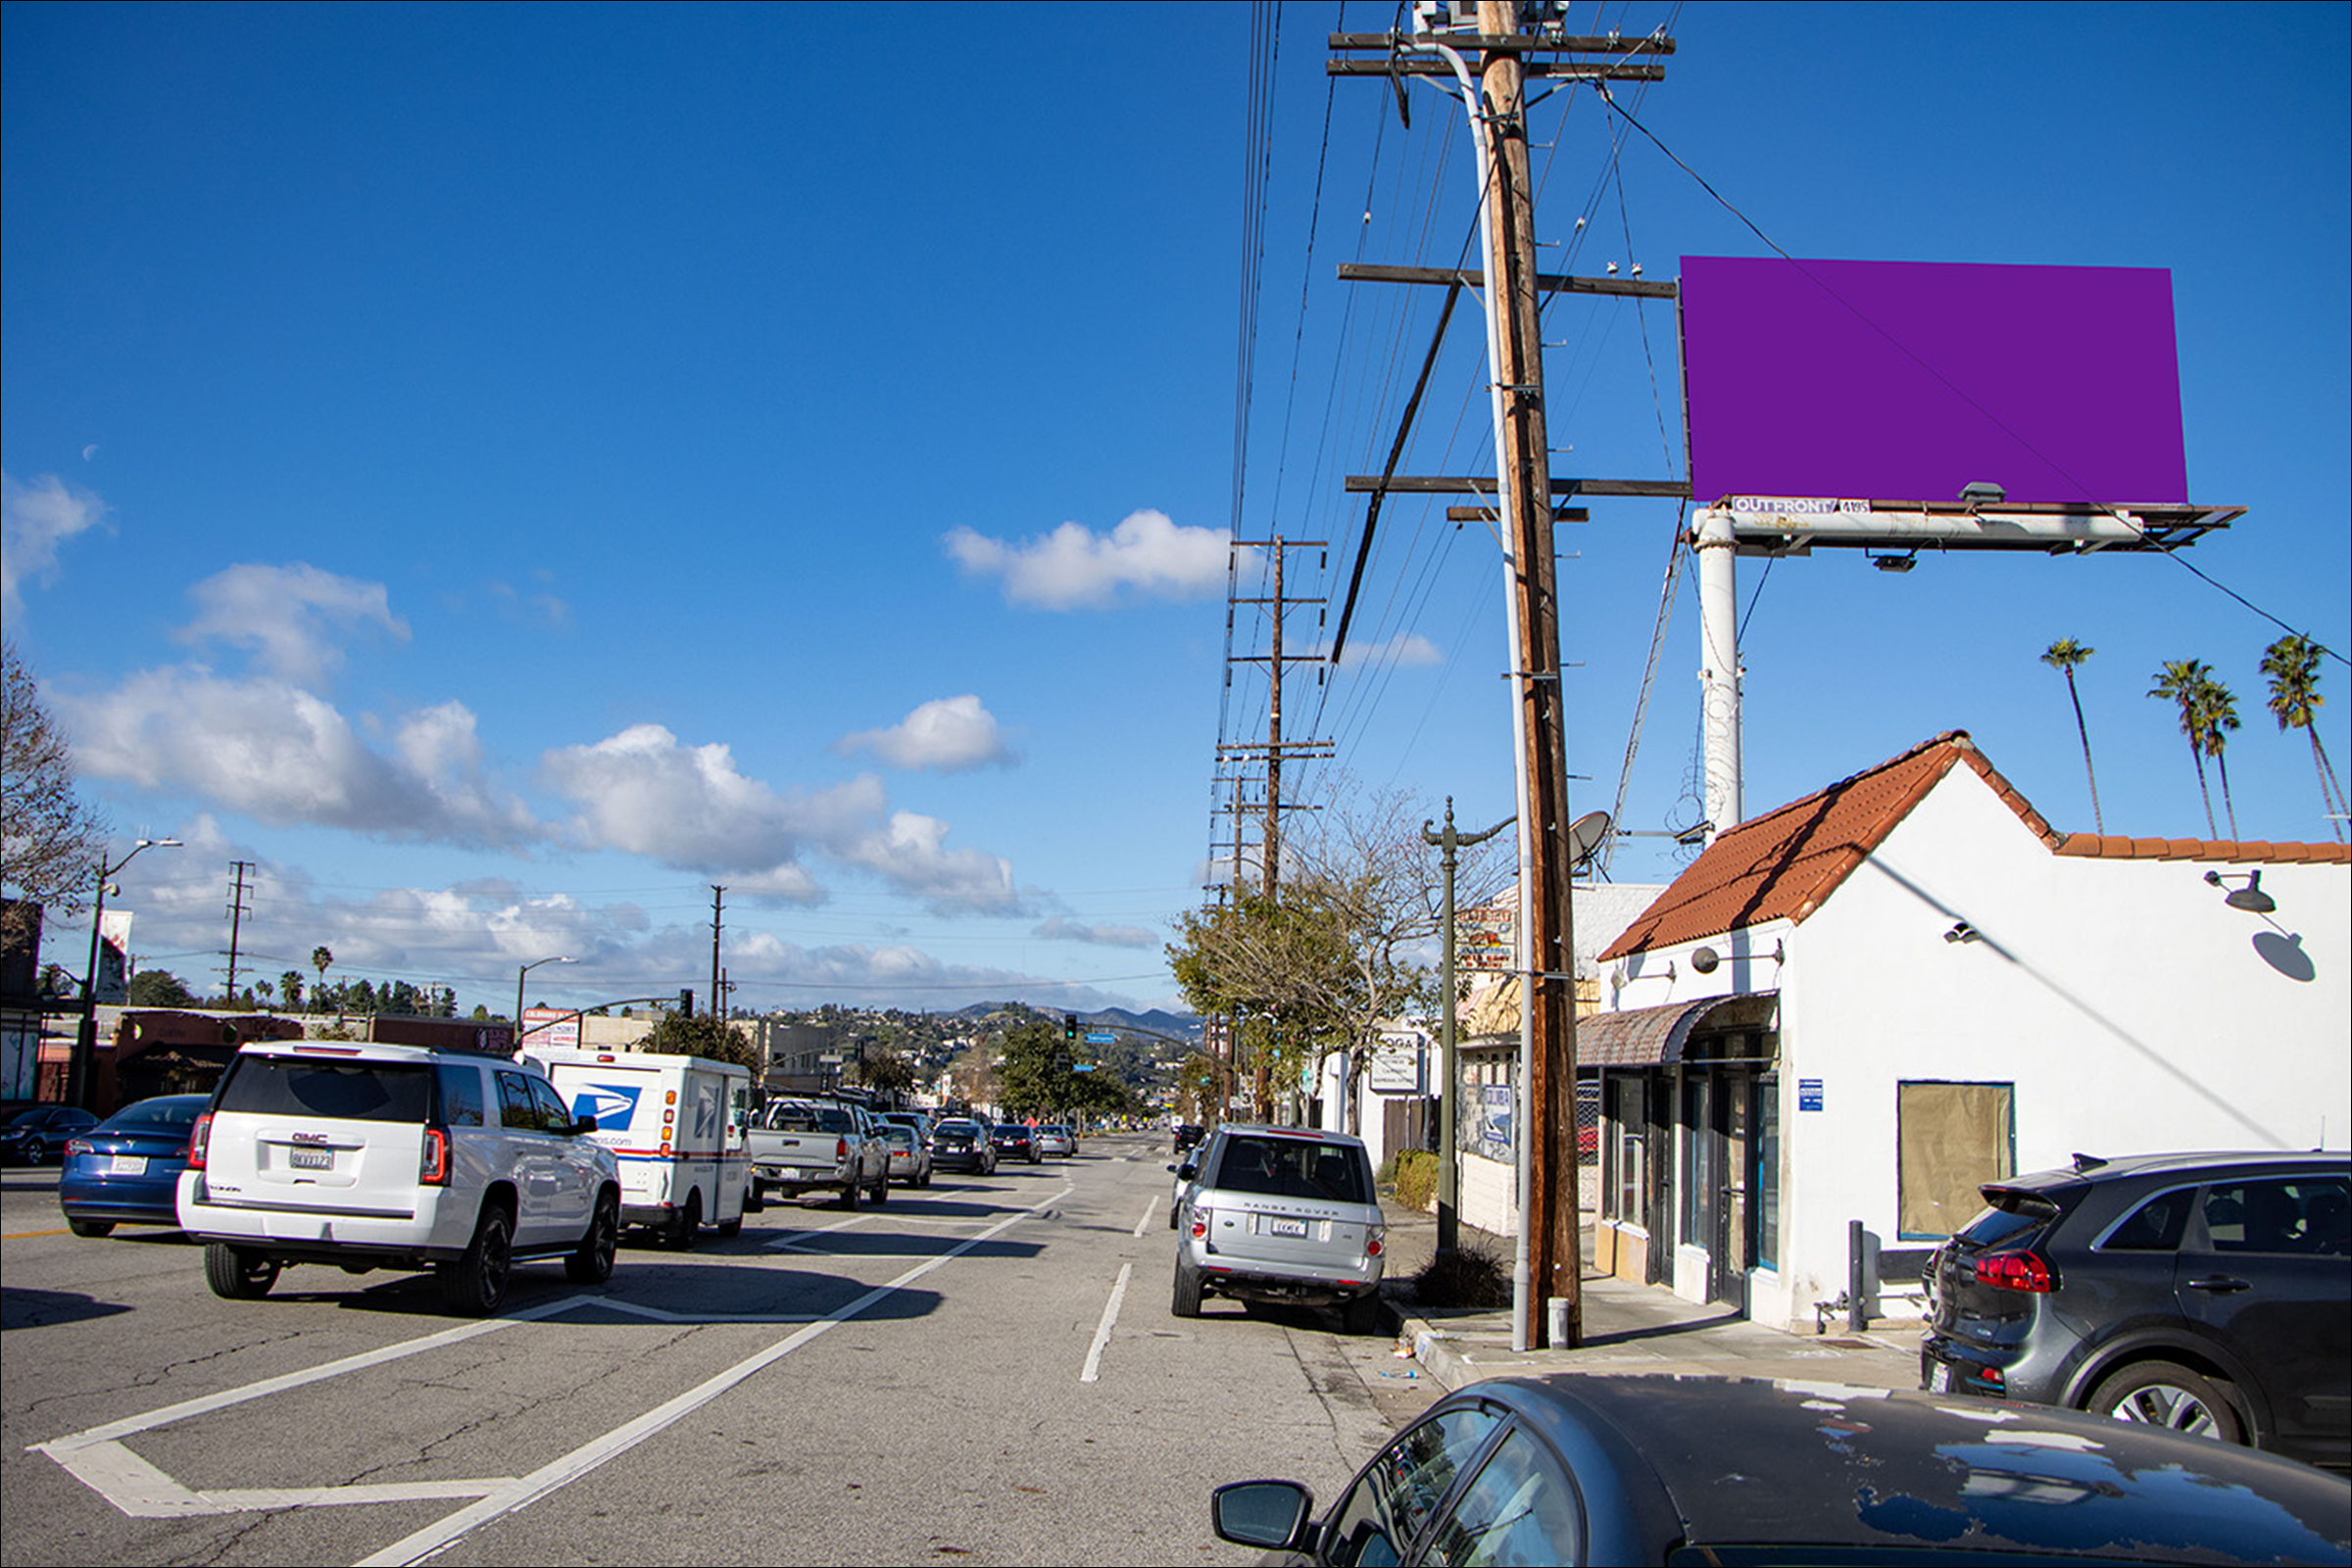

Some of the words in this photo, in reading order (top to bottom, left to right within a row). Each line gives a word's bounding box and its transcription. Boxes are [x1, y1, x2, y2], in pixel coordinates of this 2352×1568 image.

[1843, 501, 1870, 513] 4195
[1377, 1037, 1413, 1049] OGA
[292, 1132, 328, 1144] GMC
[1244, 1201, 1287, 1211] RANGE
[1295, 1206, 1340, 1216] ROVER
